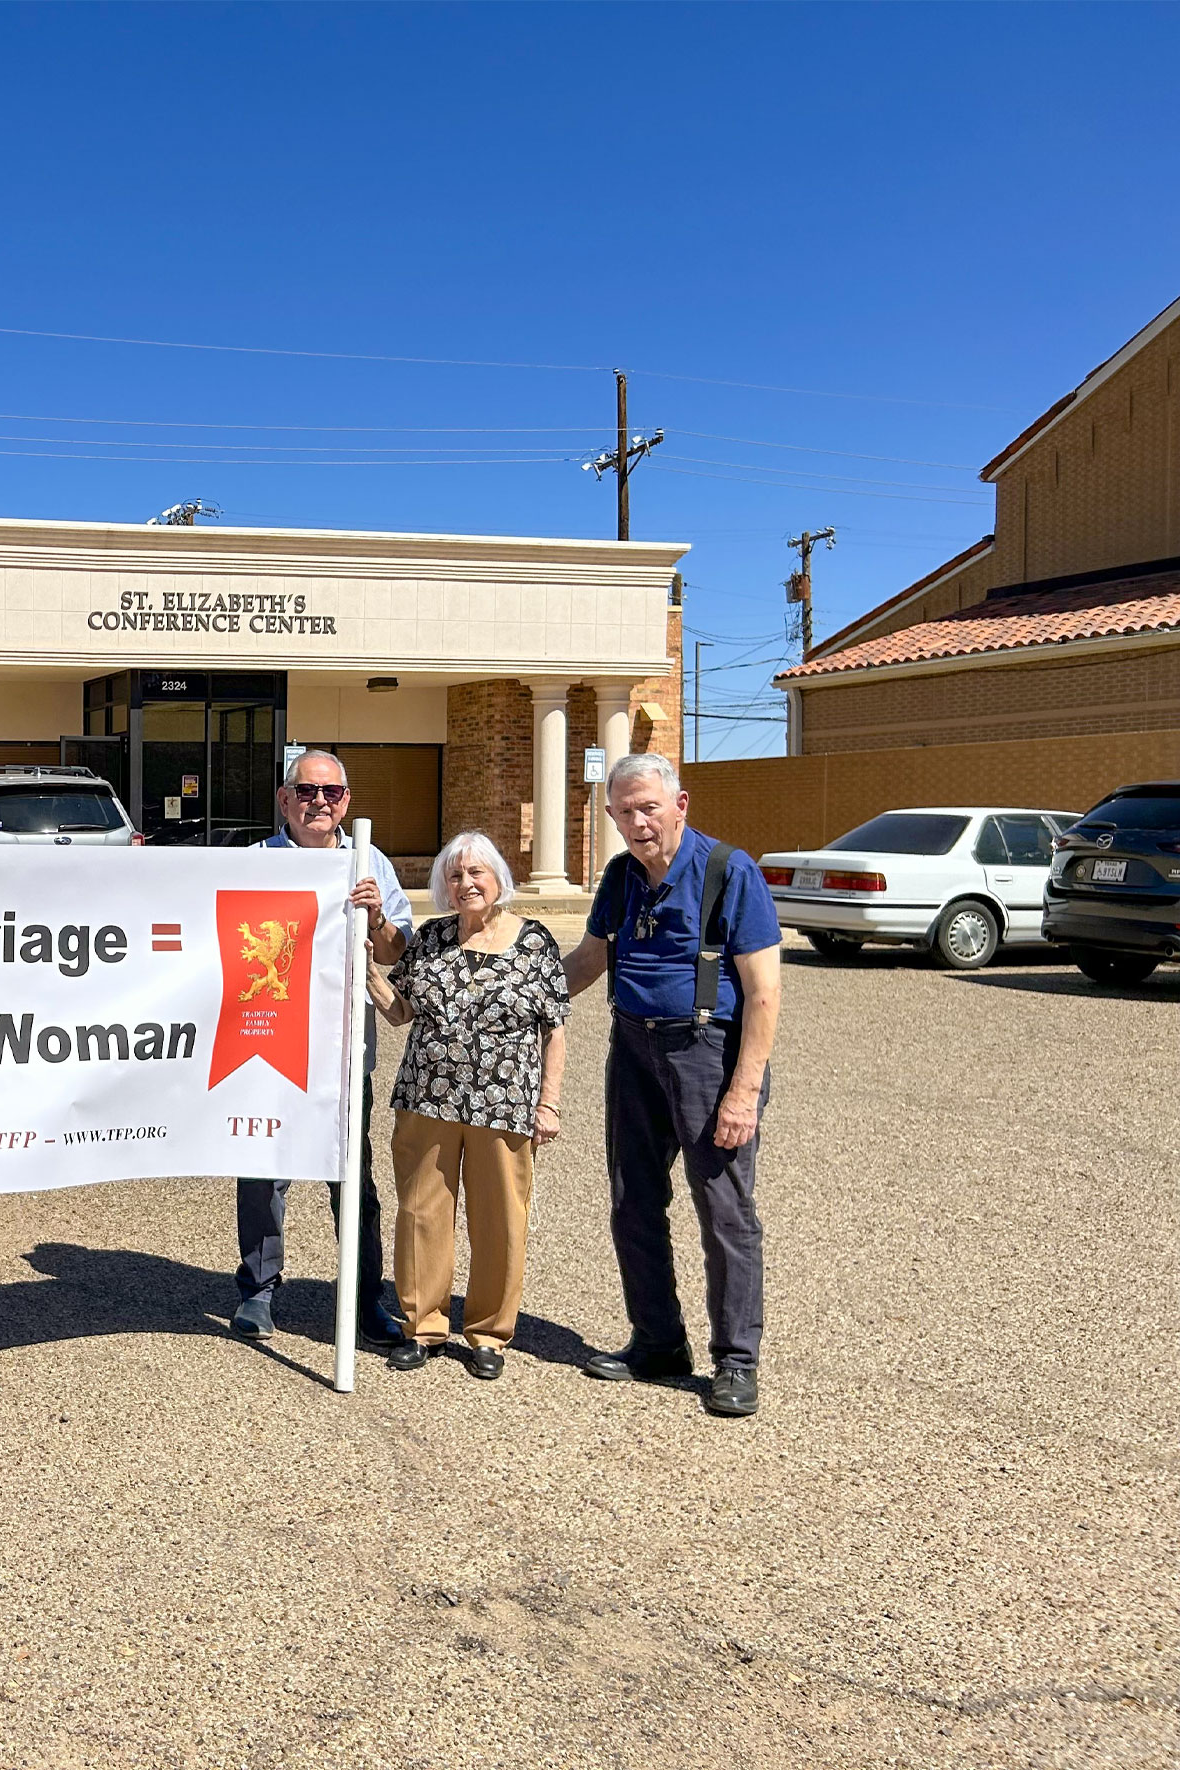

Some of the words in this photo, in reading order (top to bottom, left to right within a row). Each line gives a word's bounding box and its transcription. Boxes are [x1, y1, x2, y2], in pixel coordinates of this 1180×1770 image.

[120, 591, 153, 611] ST.
[162, 592, 307, 614] ELIZABETH'S
[87, 611, 241, 633] CONFERENCE
[248, 614, 337, 635] CENTER
[161, 681, 187, 691] 2324
[63, 1125, 168, 1147] WWW.TFP.ORG
[227, 1116, 282, 1138] TFP
